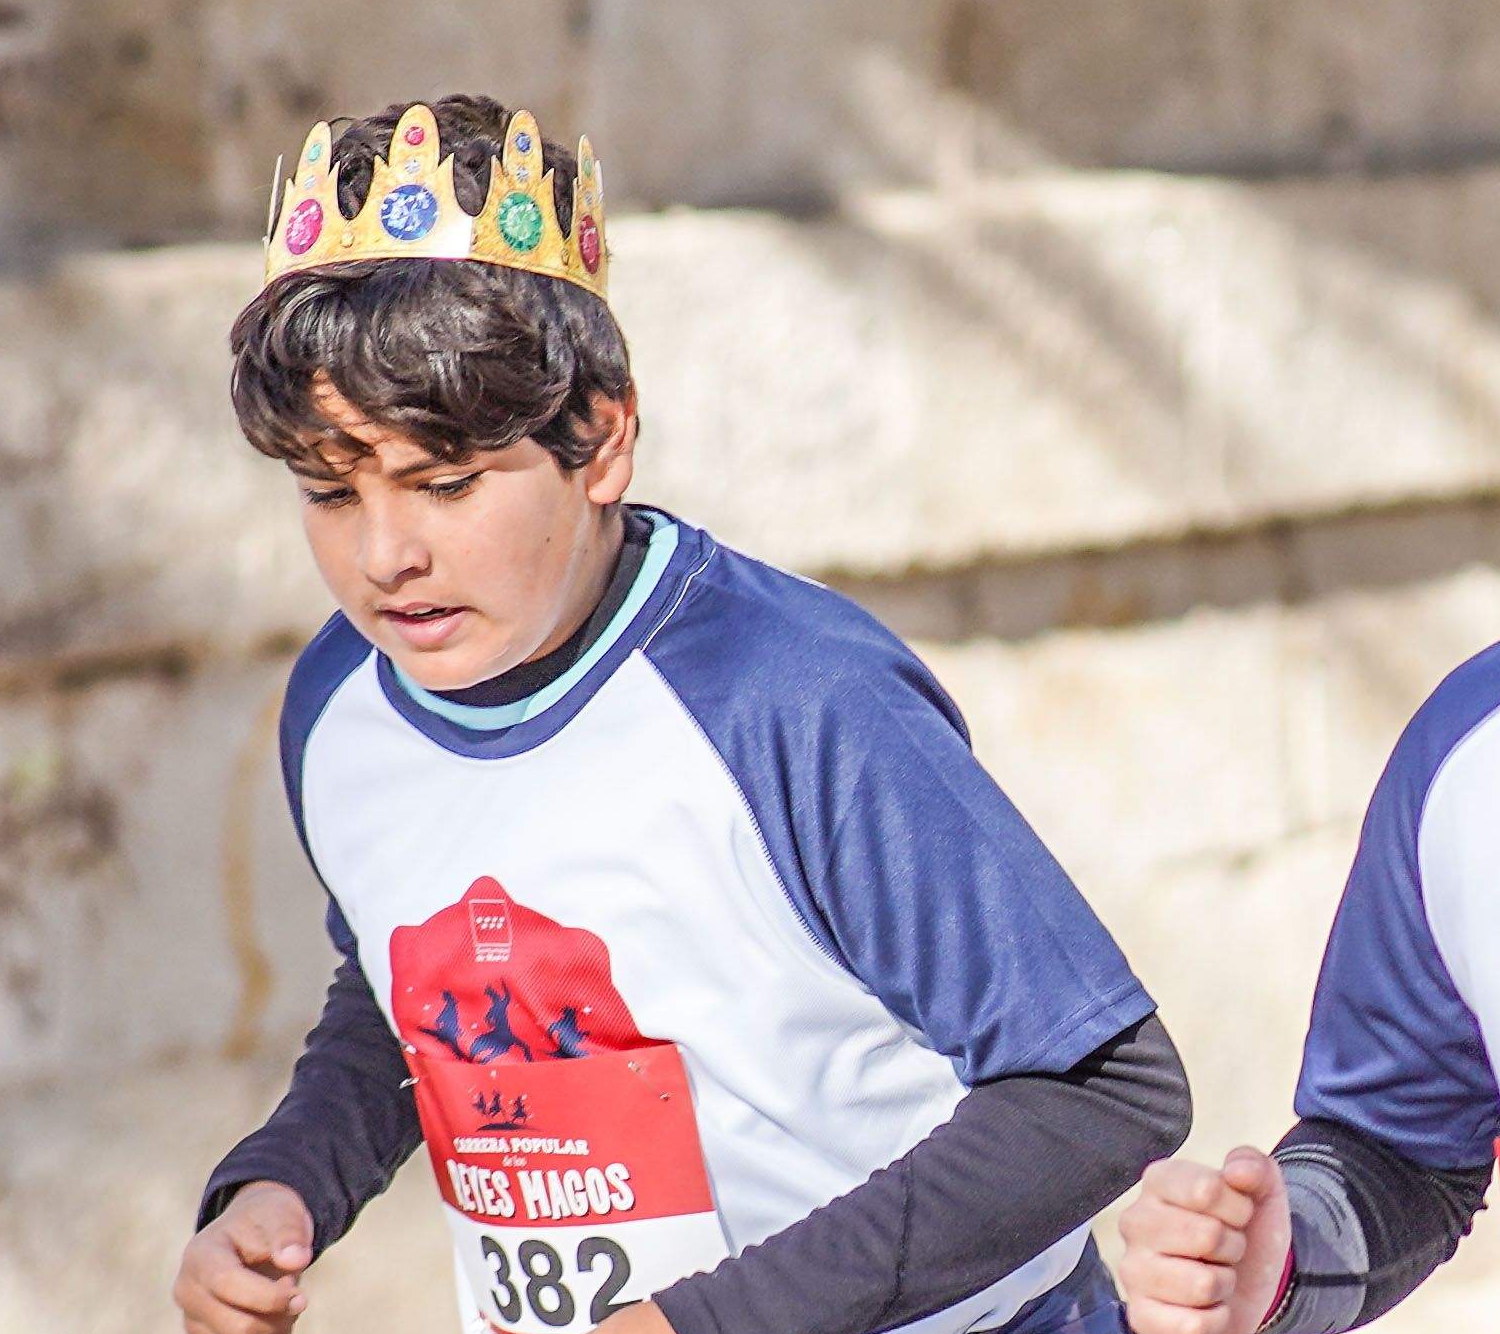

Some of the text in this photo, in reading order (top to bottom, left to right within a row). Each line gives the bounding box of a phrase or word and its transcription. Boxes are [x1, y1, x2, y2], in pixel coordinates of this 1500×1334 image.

[512, 1137, 590, 1155] POPULAR
[517, 1162, 636, 1220] MAGOS
[481, 1235, 643, 1327] 382
